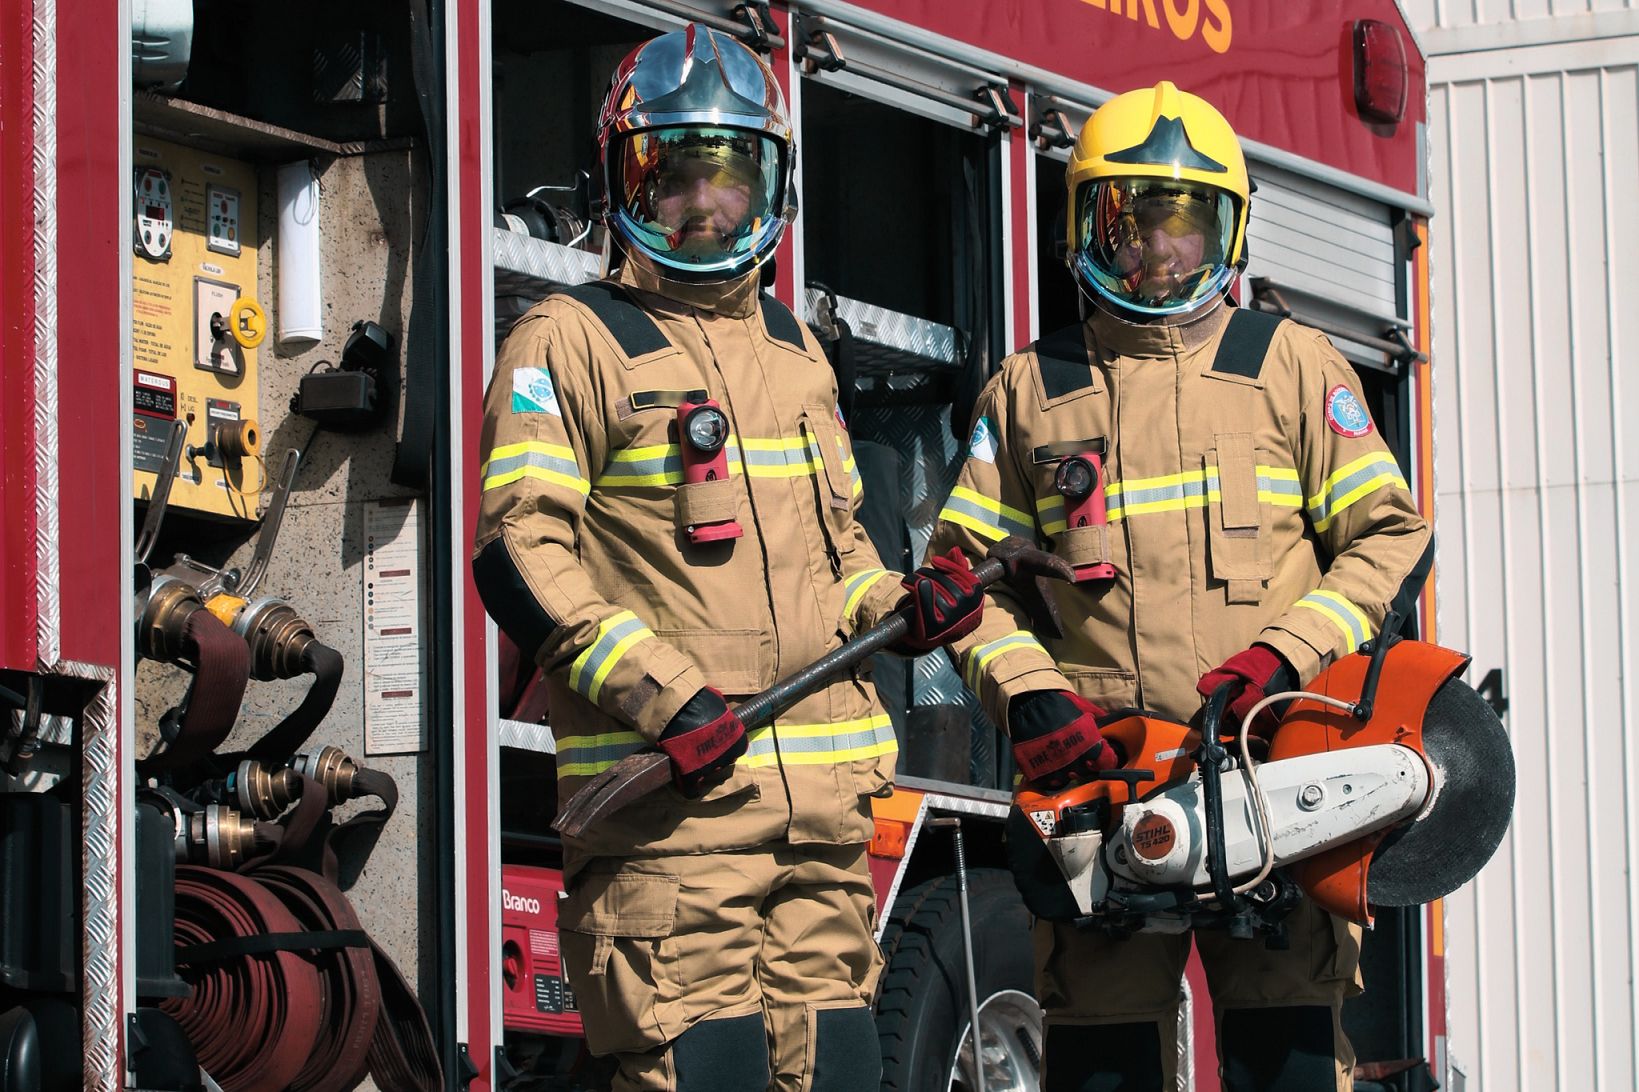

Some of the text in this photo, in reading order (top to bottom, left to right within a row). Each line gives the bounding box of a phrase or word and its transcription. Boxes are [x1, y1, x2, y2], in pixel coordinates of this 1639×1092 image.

[1476, 668, 1509, 720] 4
[1136, 825, 1170, 842] STIHL
[1140, 834, 1170, 849] TS 420
[502, 889, 540, 914] Branco
